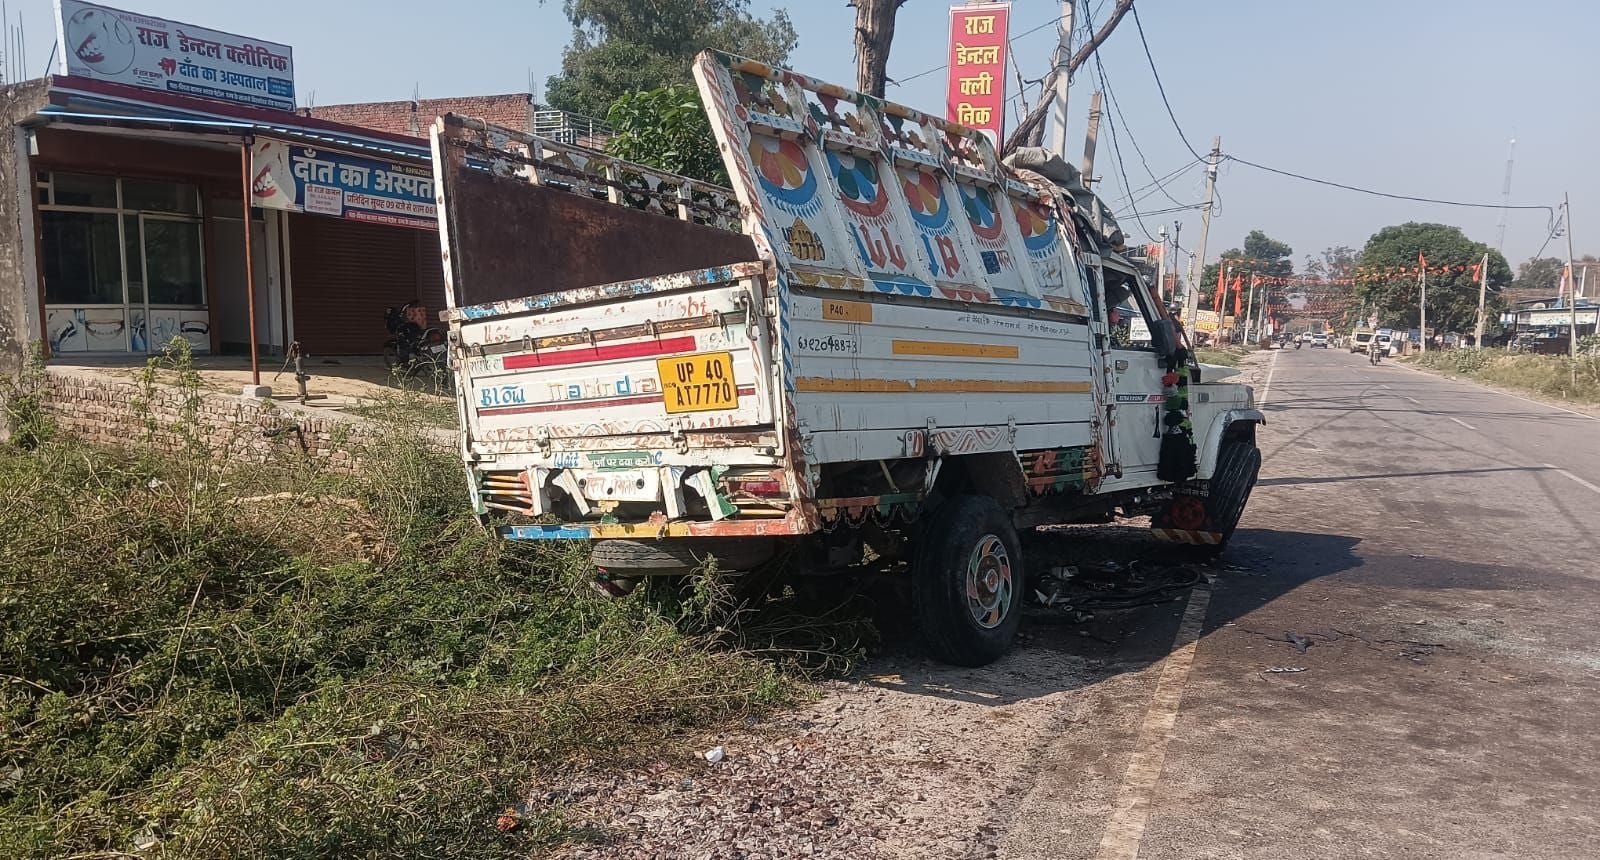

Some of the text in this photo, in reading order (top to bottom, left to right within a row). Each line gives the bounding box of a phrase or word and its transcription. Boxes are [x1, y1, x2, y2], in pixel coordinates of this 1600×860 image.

[964, 15, 996, 35] राज
[136, 26, 288, 72] राज डेन्टल क्लीनिक
[955, 42, 1000, 66] डेन्टल
[178, 57, 199, 79] दाँत
[200, 66, 217, 82] का
[220, 70, 267, 91] अस्पताल
[959, 71, 994, 95] क्ली
[957, 102, 992, 126] निक
[293, 147, 336, 184] दाँत
[339, 163, 370, 189] का
[386, 201, 395, 209] 09
[676, 359, 723, 383] UP 40
[676, 381, 732, 406] AT7770
